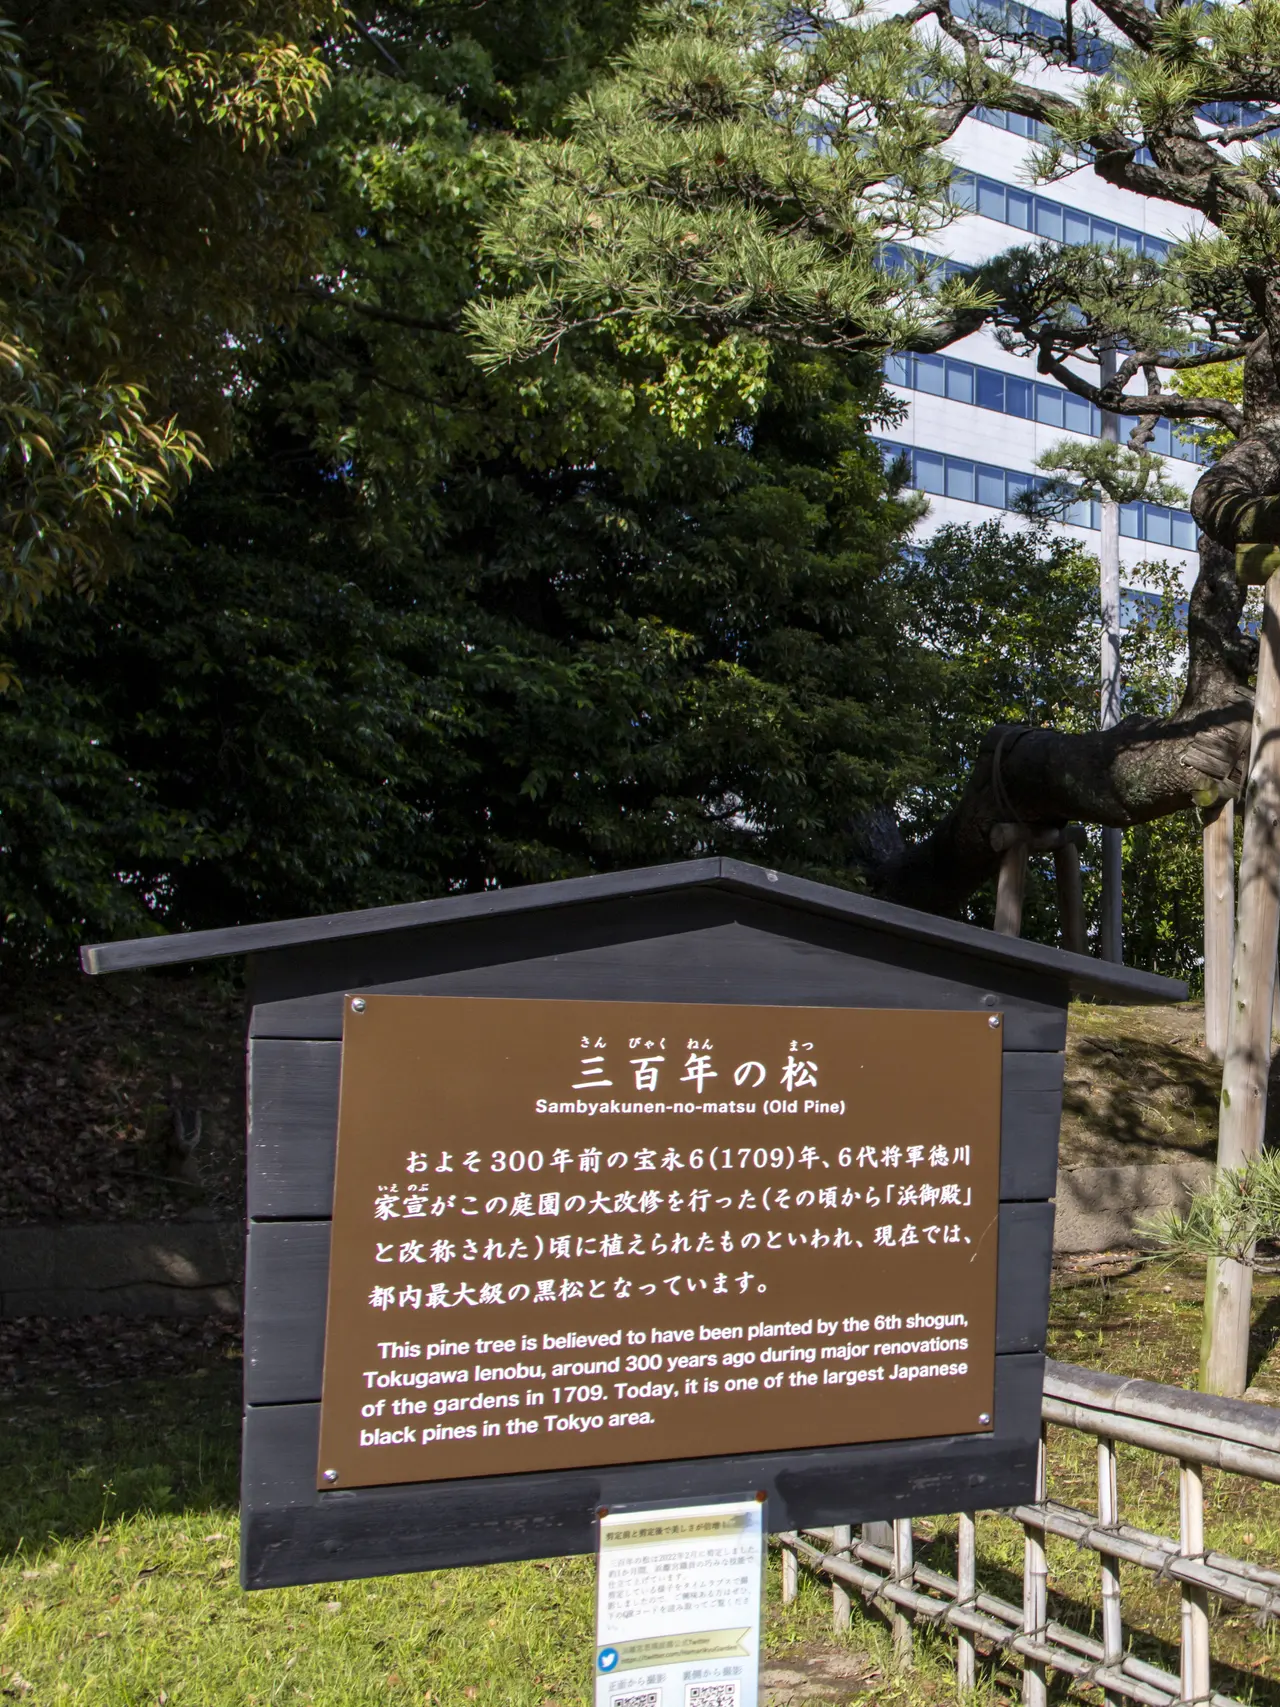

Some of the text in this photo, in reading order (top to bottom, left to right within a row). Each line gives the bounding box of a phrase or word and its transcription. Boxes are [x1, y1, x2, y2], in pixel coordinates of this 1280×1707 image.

[571, 1052, 819, 1095] 三百年の松
[535, 1098, 846, 1117] Sambyakunen-no-matsu (Old Pine)
[367, 1270, 767, 1312] 都内最大級の黒松となっています。
[376, 1312, 969, 1361] This pine tree is believed to have been planted by the 6th shogun,
[362, 1336, 969, 1390] Tokugawa Ienobu, around 300 years ago during major renovations
[360, 1362, 969, 1419] of the gardens in 1709. Today, it is one of the largest Japanese
[359, 1411, 656, 1447] black pines in the Tokyo area.
